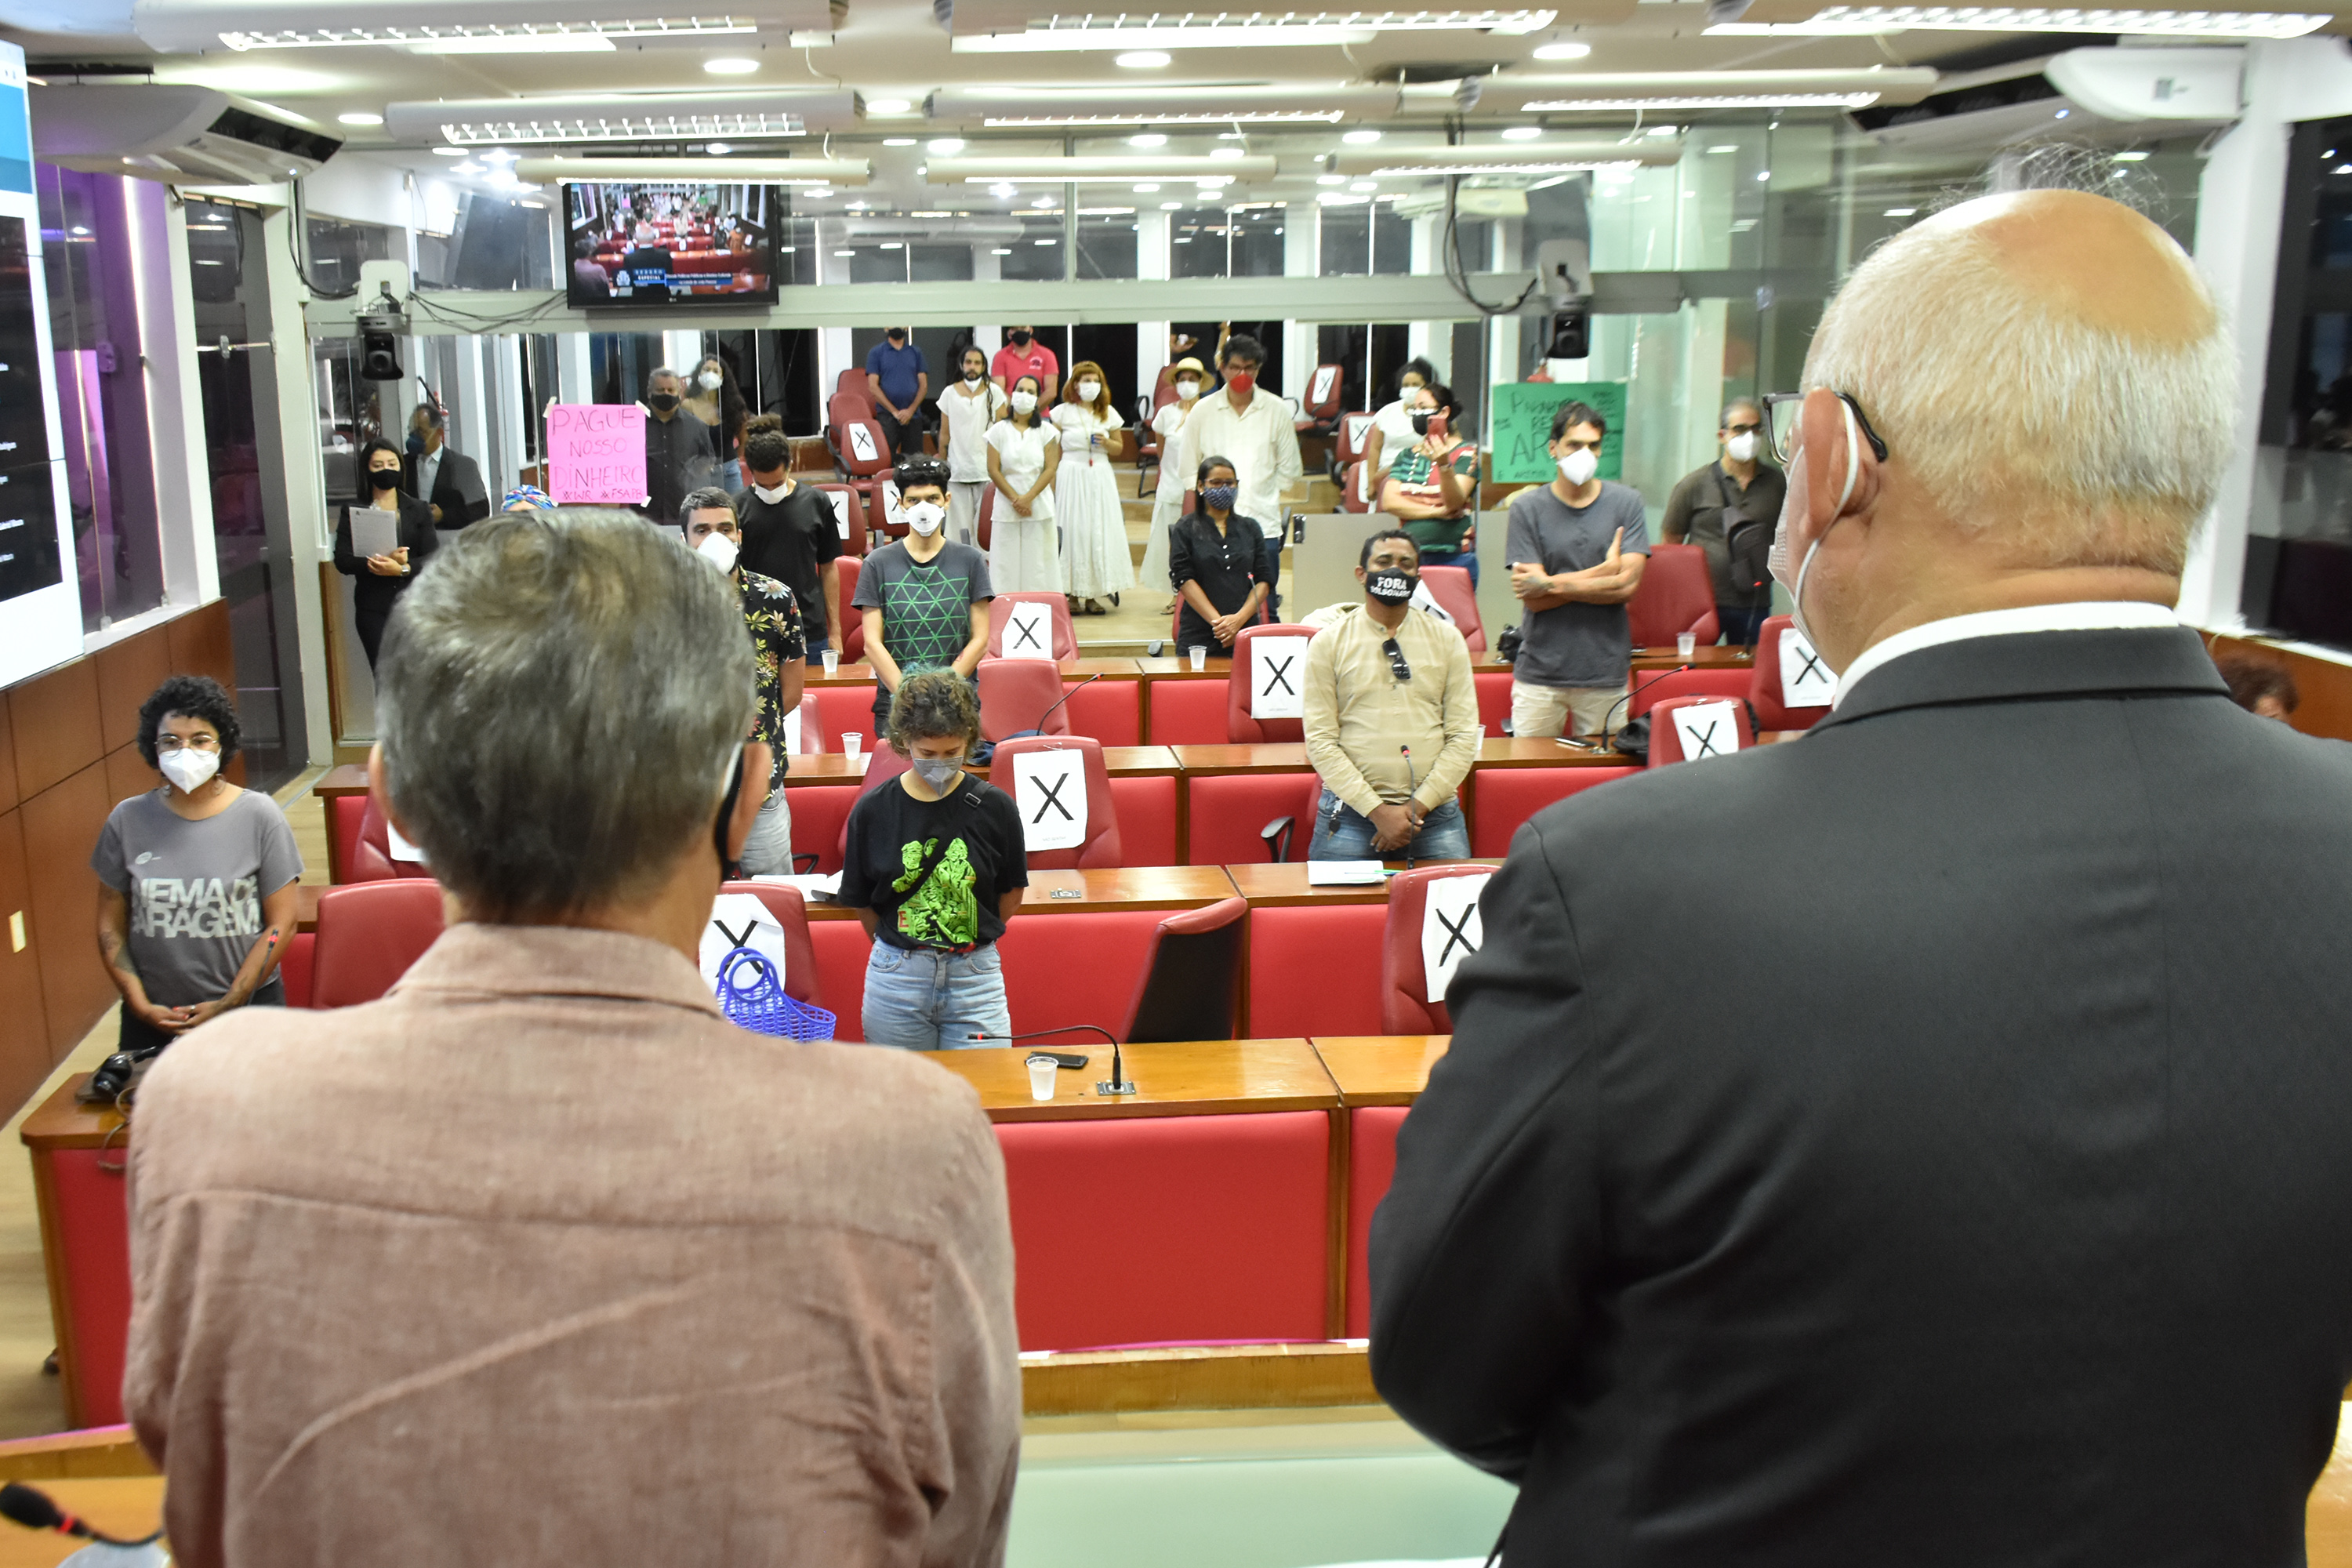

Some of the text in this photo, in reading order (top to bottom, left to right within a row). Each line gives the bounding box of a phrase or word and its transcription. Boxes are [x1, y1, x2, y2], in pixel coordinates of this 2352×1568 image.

[552, 407, 639, 436] PAGUE
[570, 437, 627, 458] NOSSO
[1377, 576, 1407, 590] FORA
